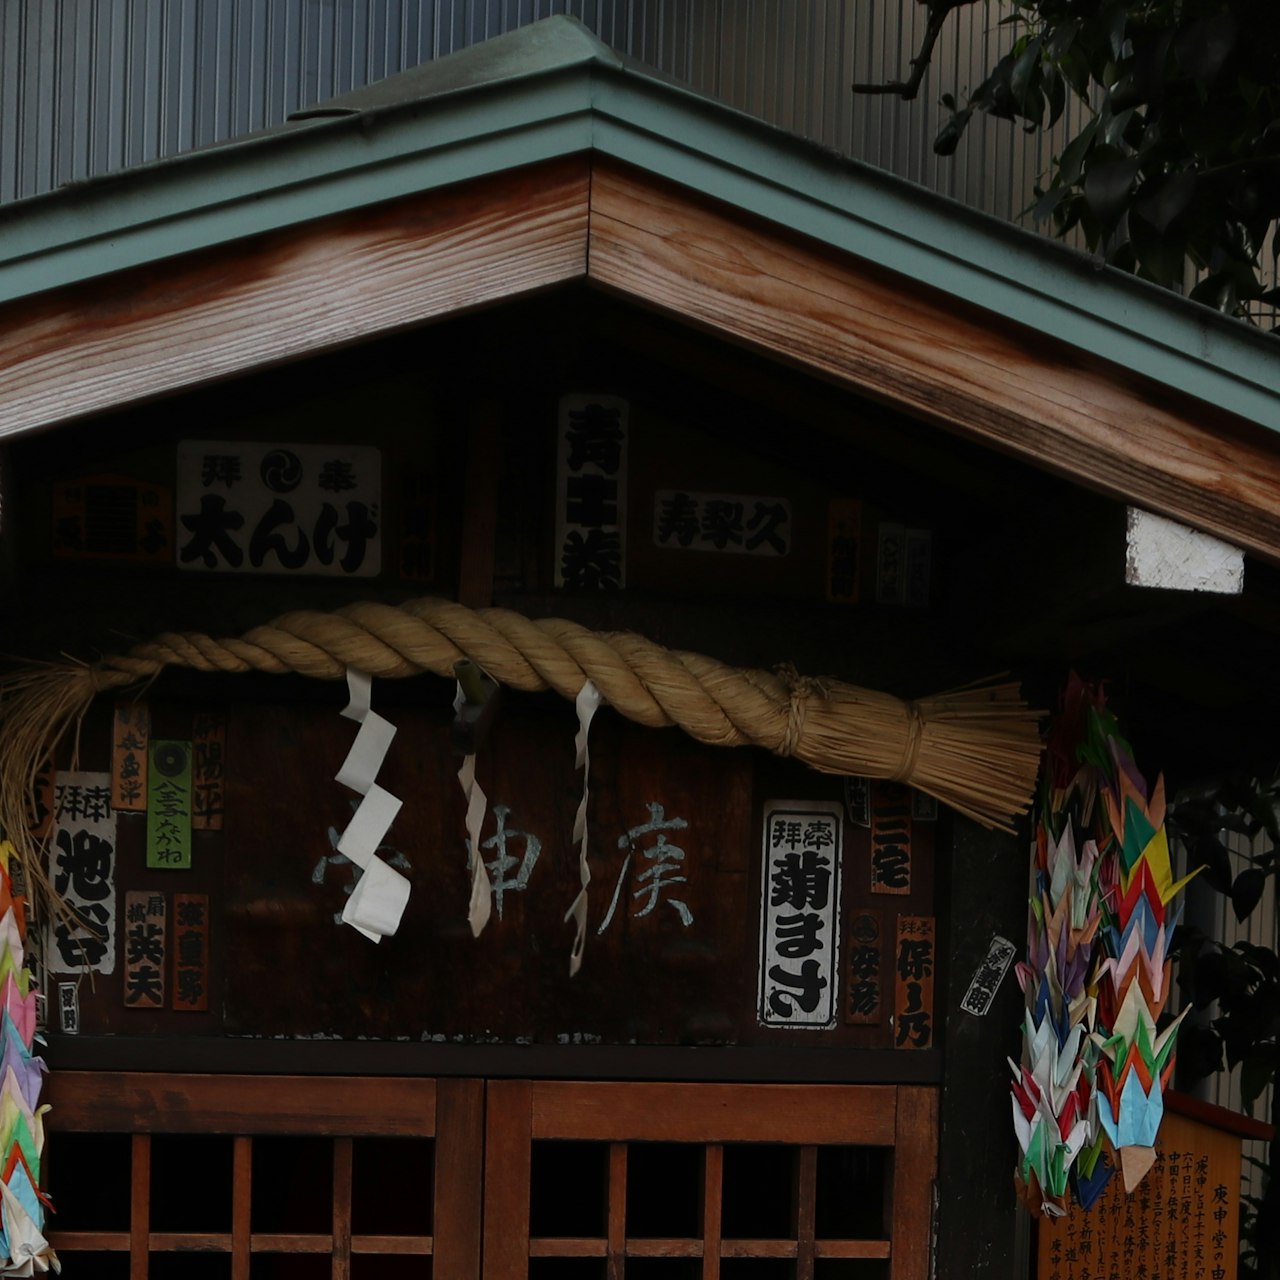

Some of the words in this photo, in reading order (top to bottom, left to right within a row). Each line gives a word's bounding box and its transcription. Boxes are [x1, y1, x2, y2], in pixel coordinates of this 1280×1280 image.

[56, 829, 114, 968] 池谷
[126, 923, 164, 1005] 英夫
[768, 852, 832, 1018] 菊まさ
